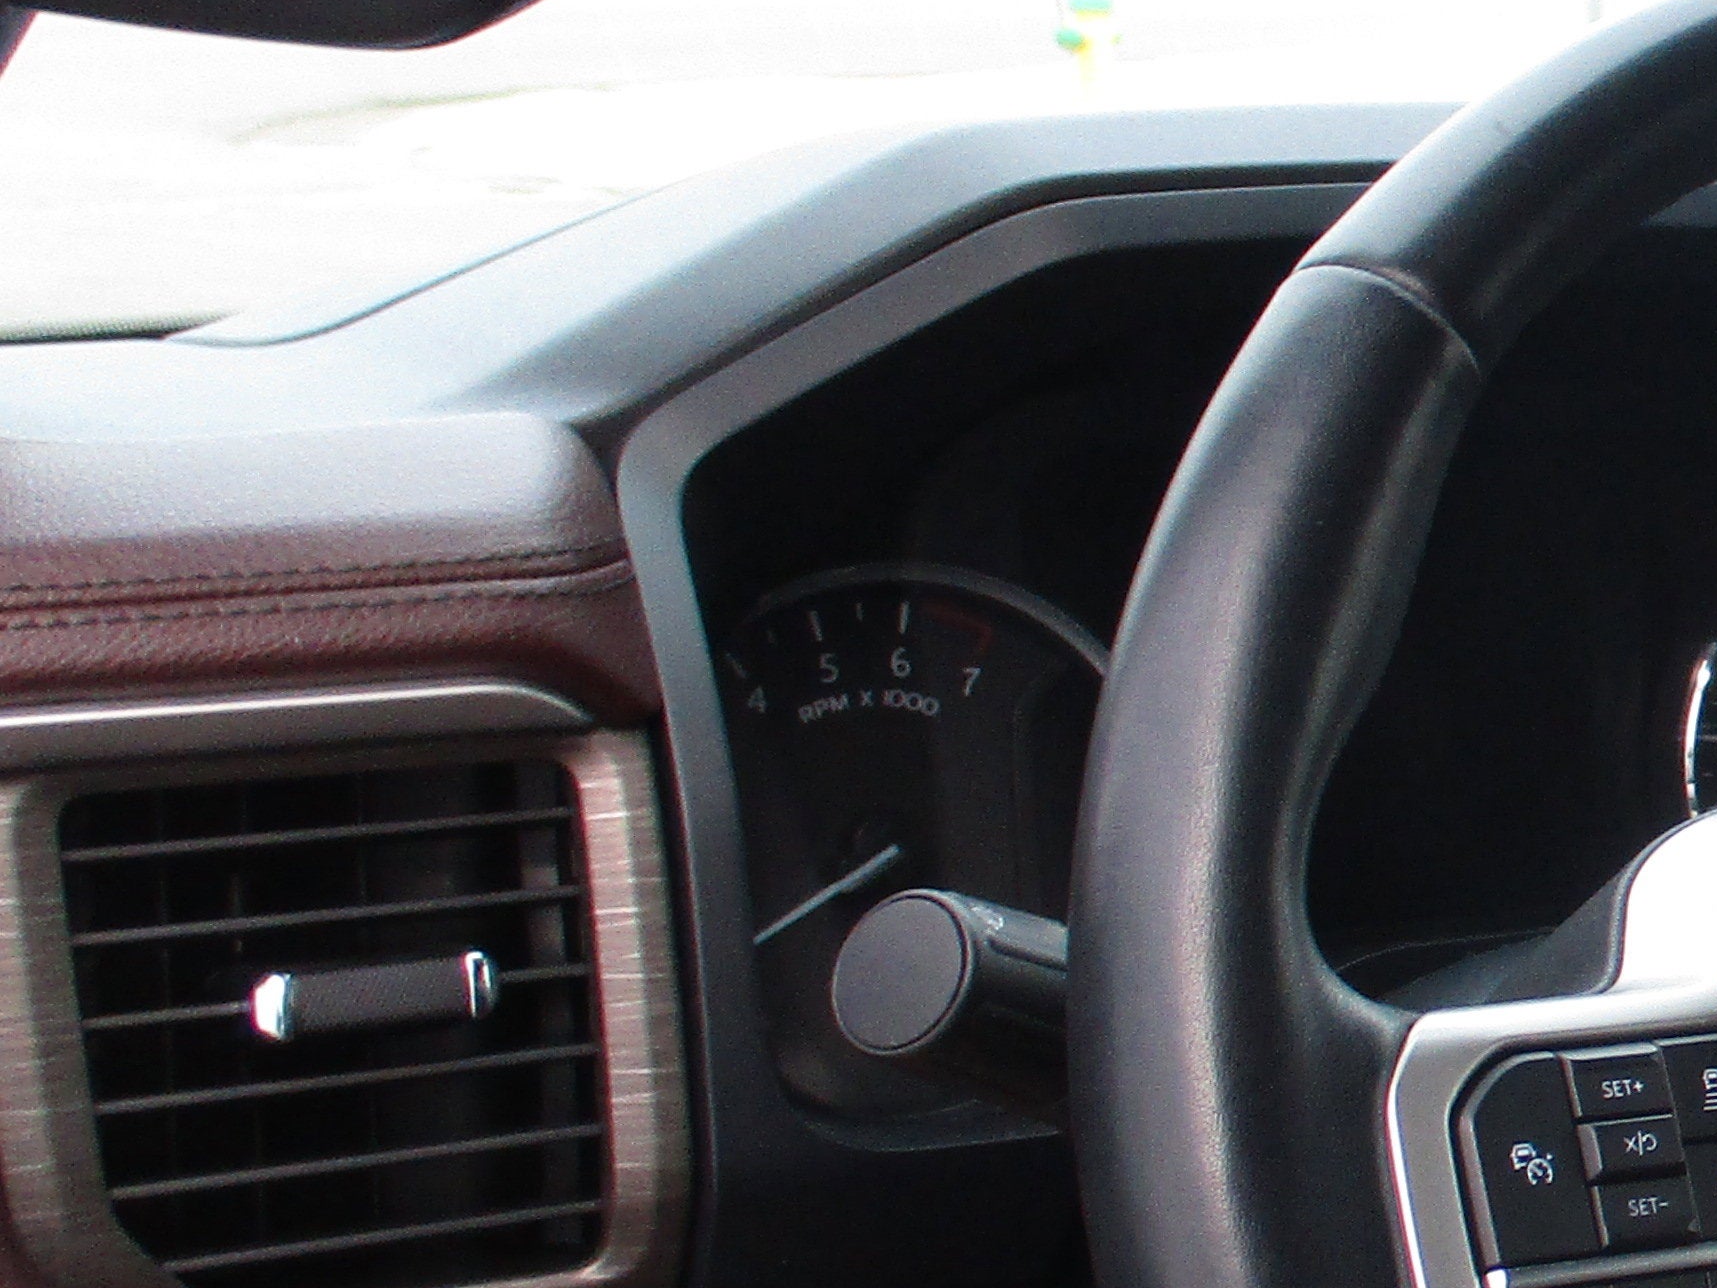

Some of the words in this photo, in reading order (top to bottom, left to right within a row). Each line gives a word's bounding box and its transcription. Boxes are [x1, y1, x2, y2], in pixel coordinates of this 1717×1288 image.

[818, 653, 840, 684] 5
[890, 647, 912, 679] 6
[962, 667, 982, 698] 7
[747, 686, 767, 713] 4
[799, 692, 851, 724] RPM
[881, 689, 942, 717] 1000
[1601, 1079, 1645, 1100] SET+
